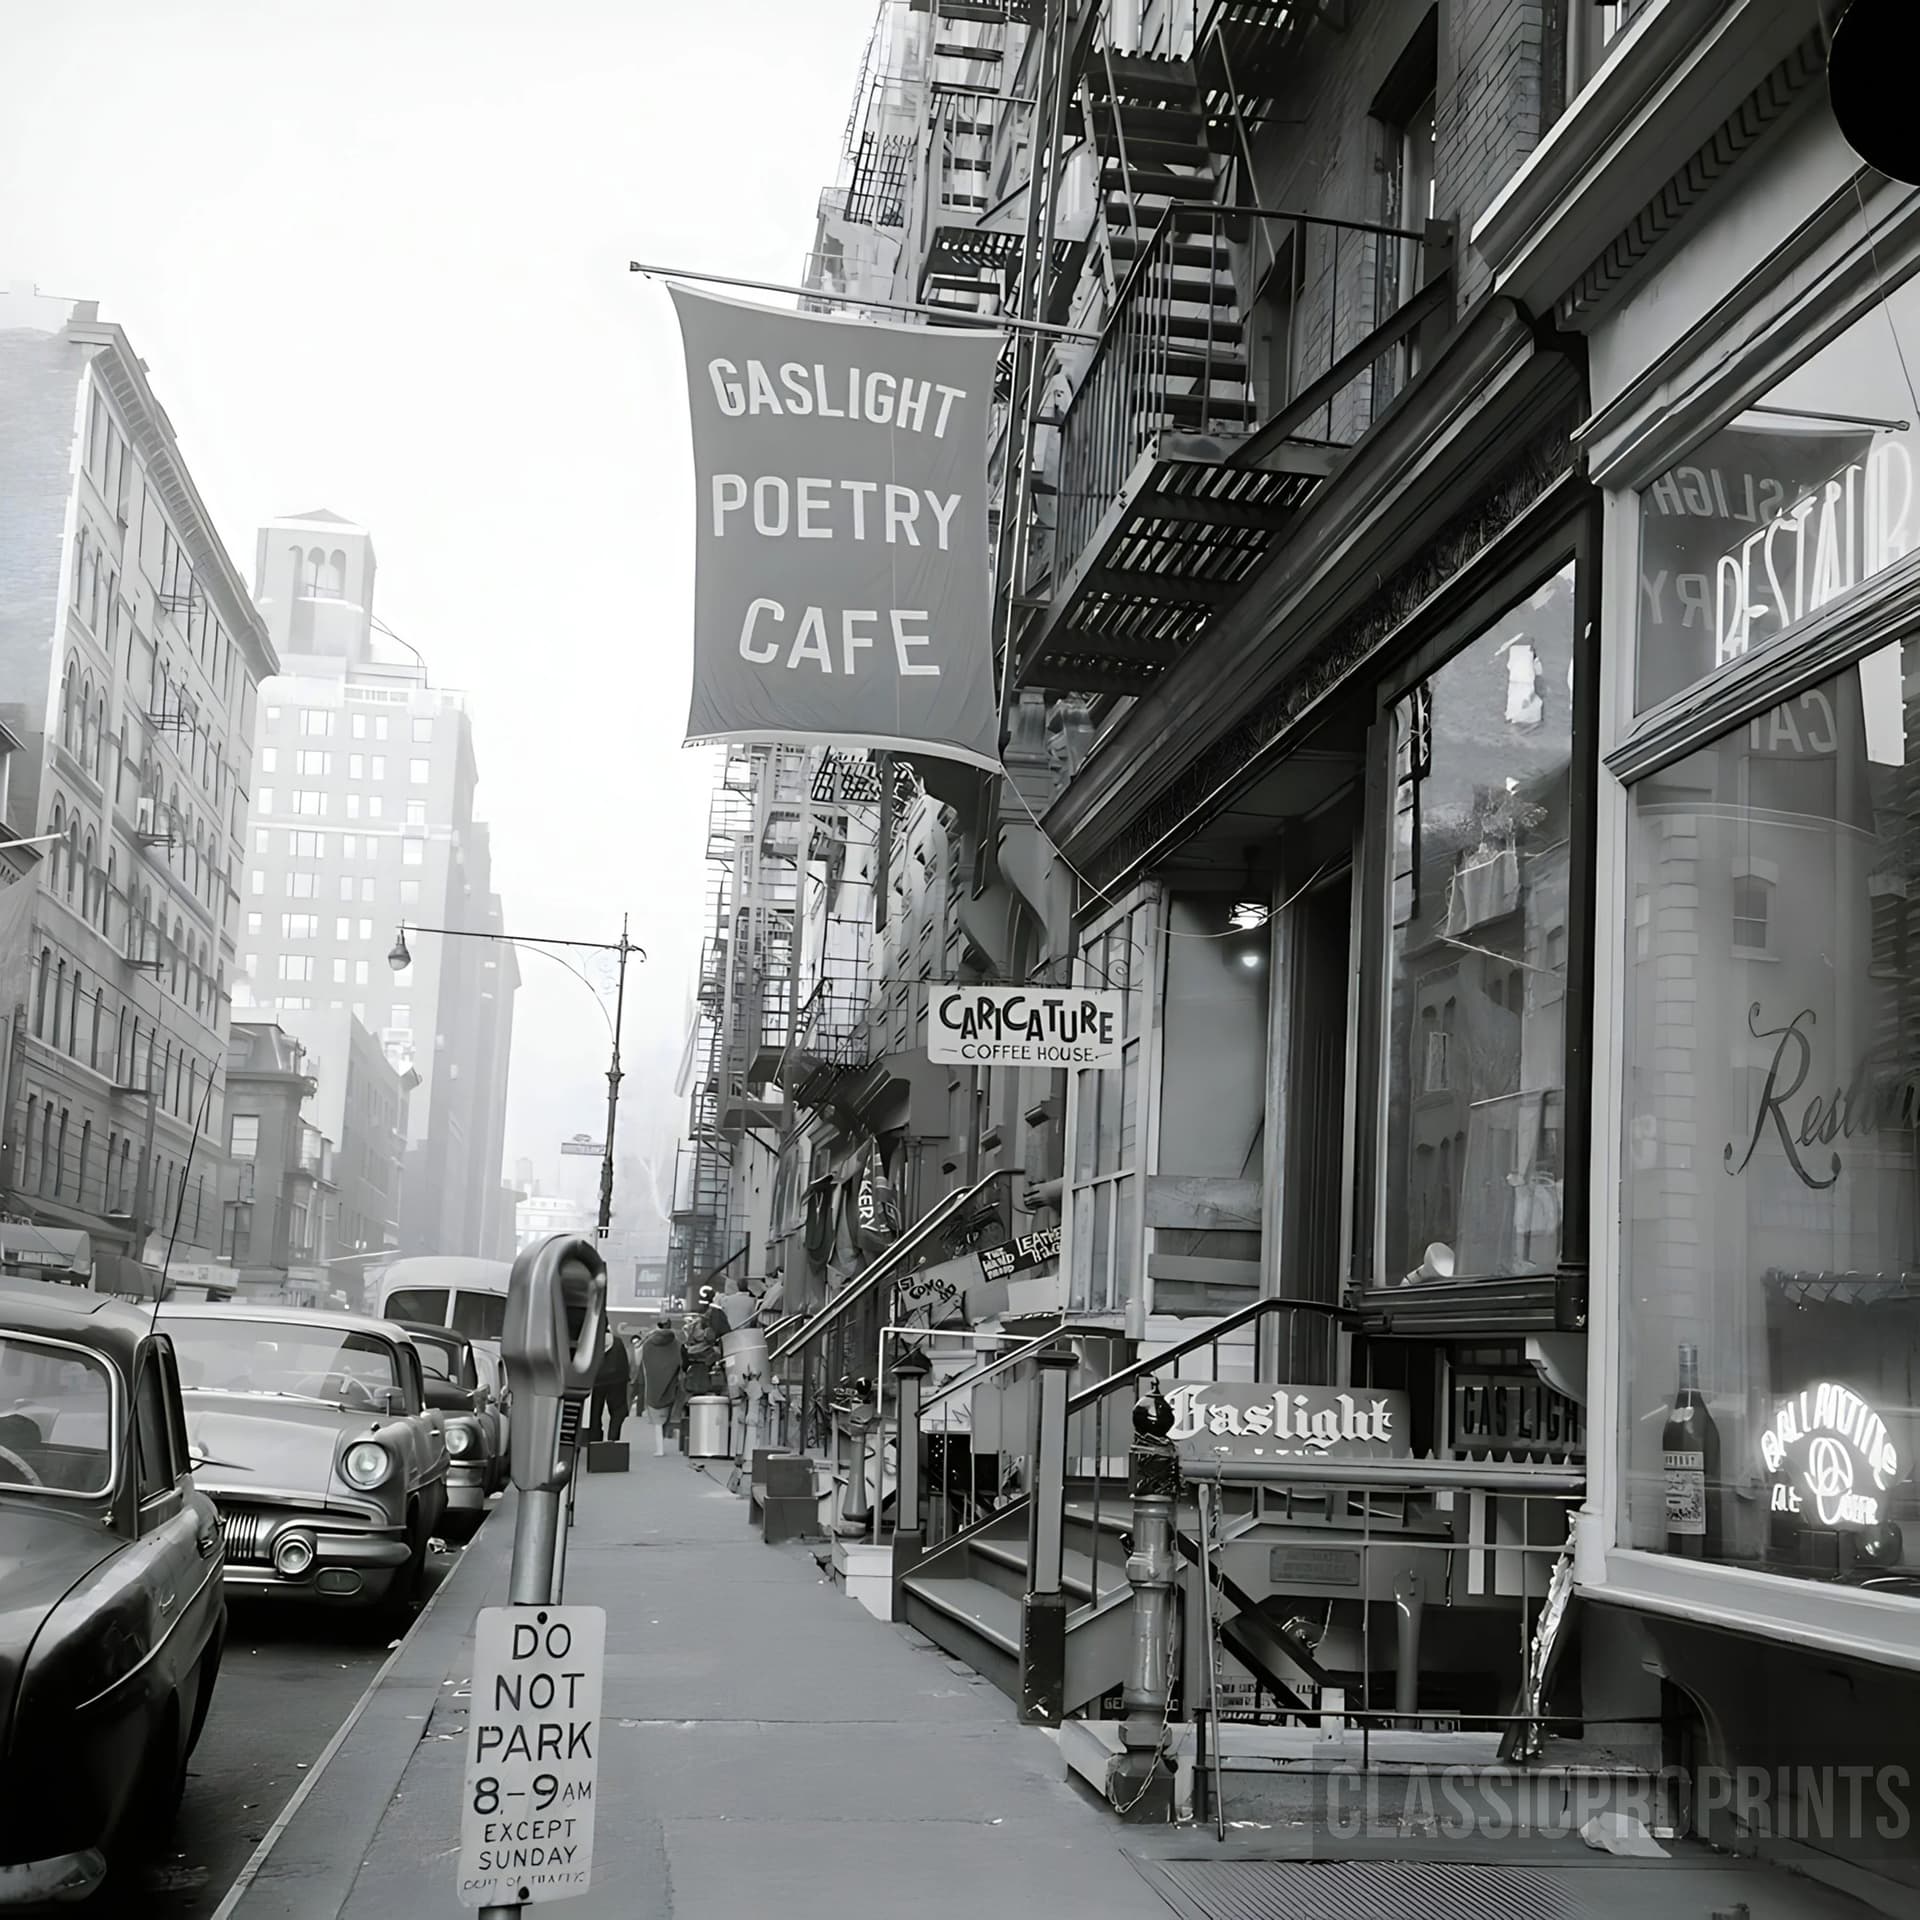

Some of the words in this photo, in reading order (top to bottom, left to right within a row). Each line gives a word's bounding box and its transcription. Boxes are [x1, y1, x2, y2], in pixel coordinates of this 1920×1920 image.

[708, 357, 966, 439] GASLIGHT
[711, 474, 962, 551] POETRY
[738, 597, 940, 676] CAFE
[939, 994, 1114, 1044] CARICATURE
[961, 1044, 1031, 1060] COFFEE
[512, 1623, 571, 1660] DO
[495, 1673, 585, 1711] NOT
[476, 1721, 592, 1764] PARK
[484, 1819, 577, 1843] EXCEPT
[478, 1845, 578, 1871] SUNDAY
